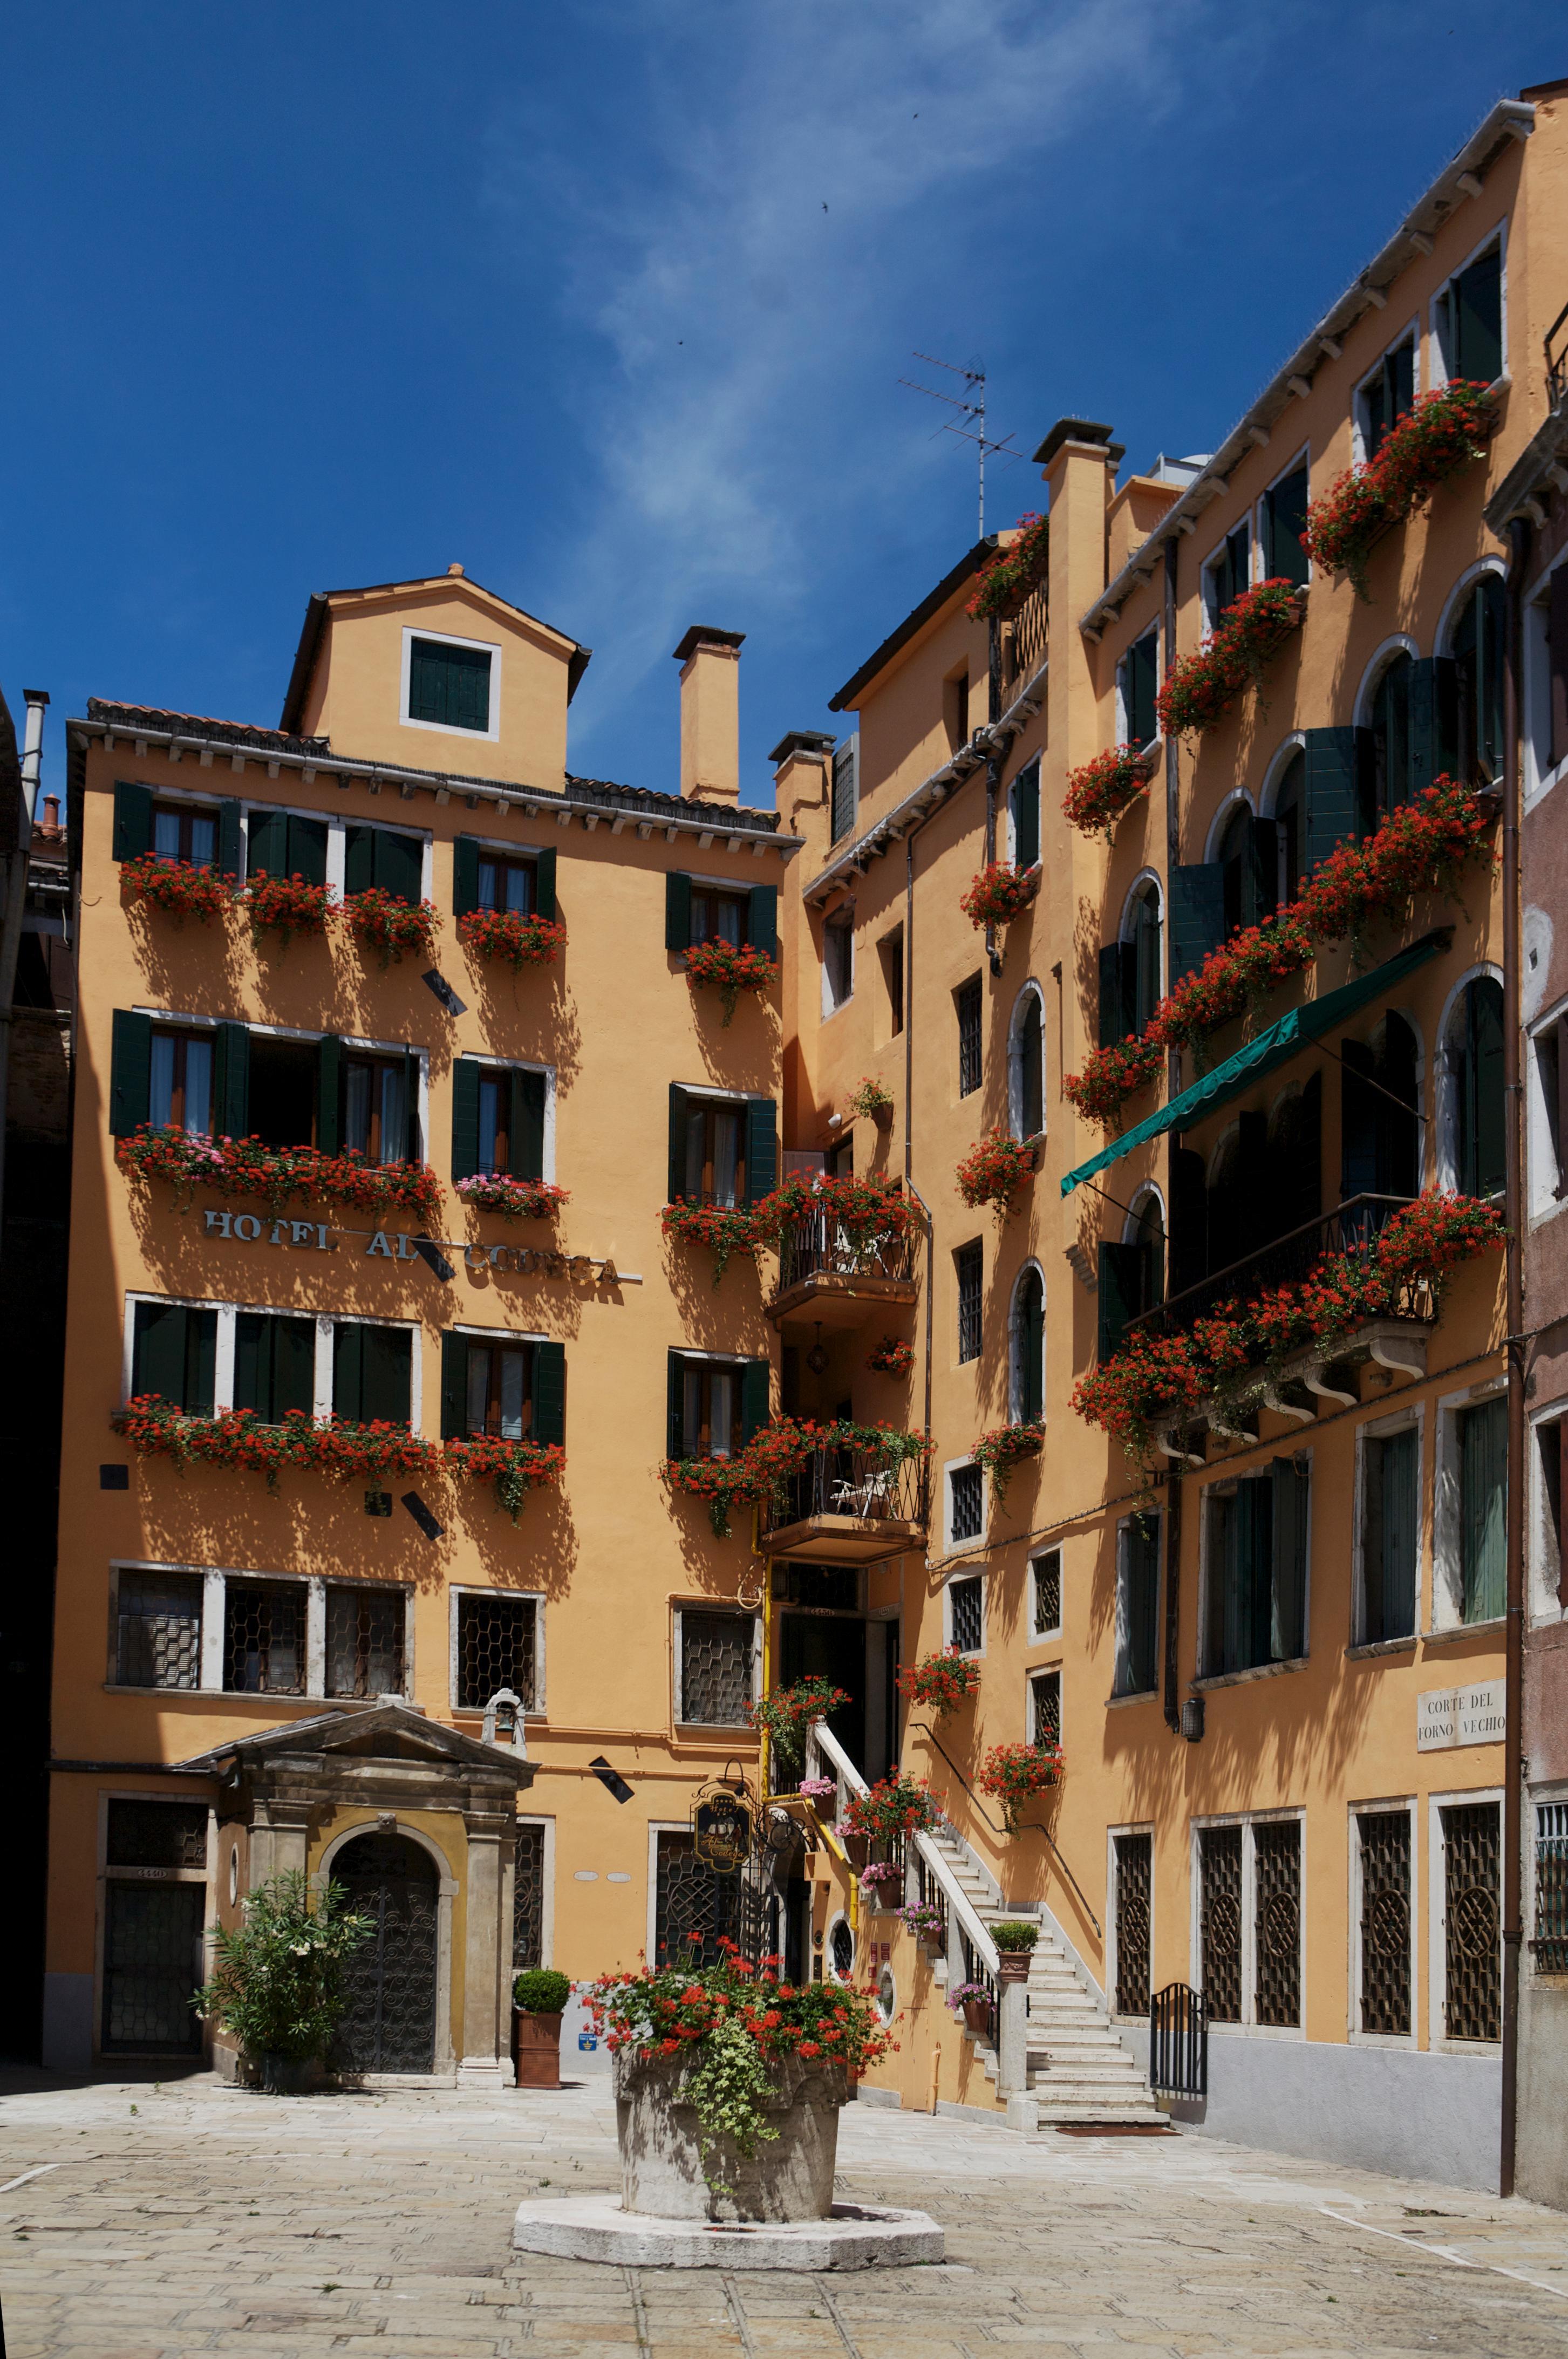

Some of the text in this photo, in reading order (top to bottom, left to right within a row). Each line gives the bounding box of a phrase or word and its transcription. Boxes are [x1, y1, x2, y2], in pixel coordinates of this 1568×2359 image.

[204, 1210, 621, 1284] HOTEL AL CODEGA
[1428, 1693, 1493, 1714] CORTE DEL
[1419, 1716, 1505, 1740] FORNO VECHIO
[709, 1803, 739, 1813] Hotel
[701, 1834, 718, 1846] Al
[708, 1845, 744, 1860] Codega
